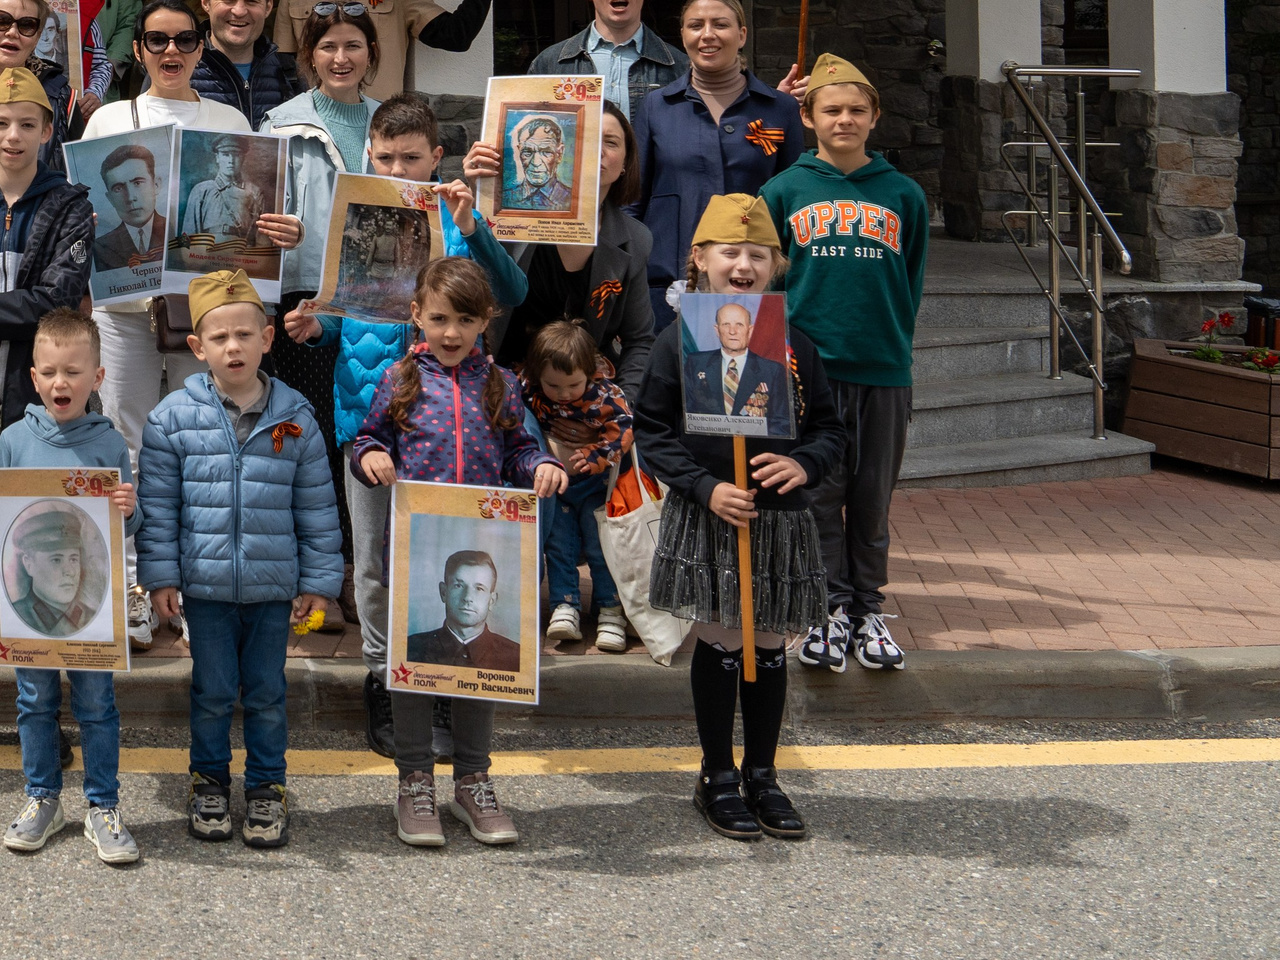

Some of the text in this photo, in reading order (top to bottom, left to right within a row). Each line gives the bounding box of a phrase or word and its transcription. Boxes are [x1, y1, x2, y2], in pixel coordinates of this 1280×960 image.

[576, 84, 587, 101] 9
[789, 200, 901, 255] UPPER
[812, 246, 883, 259] EAST SIDE
[109, 280, 147, 294] Николай
[687, 414, 764, 425] Яковенко Александр
[687, 424, 731, 433] Степанович
[90, 478, 102, 496] 9
[506, 500, 518, 521] 9
[12, 654, 35, 663] ПОЛК
[477, 670, 516, 682] Воронов
[413, 679, 437, 688] ПОЛК
[457, 680, 535, 696] Петр Васильевич
